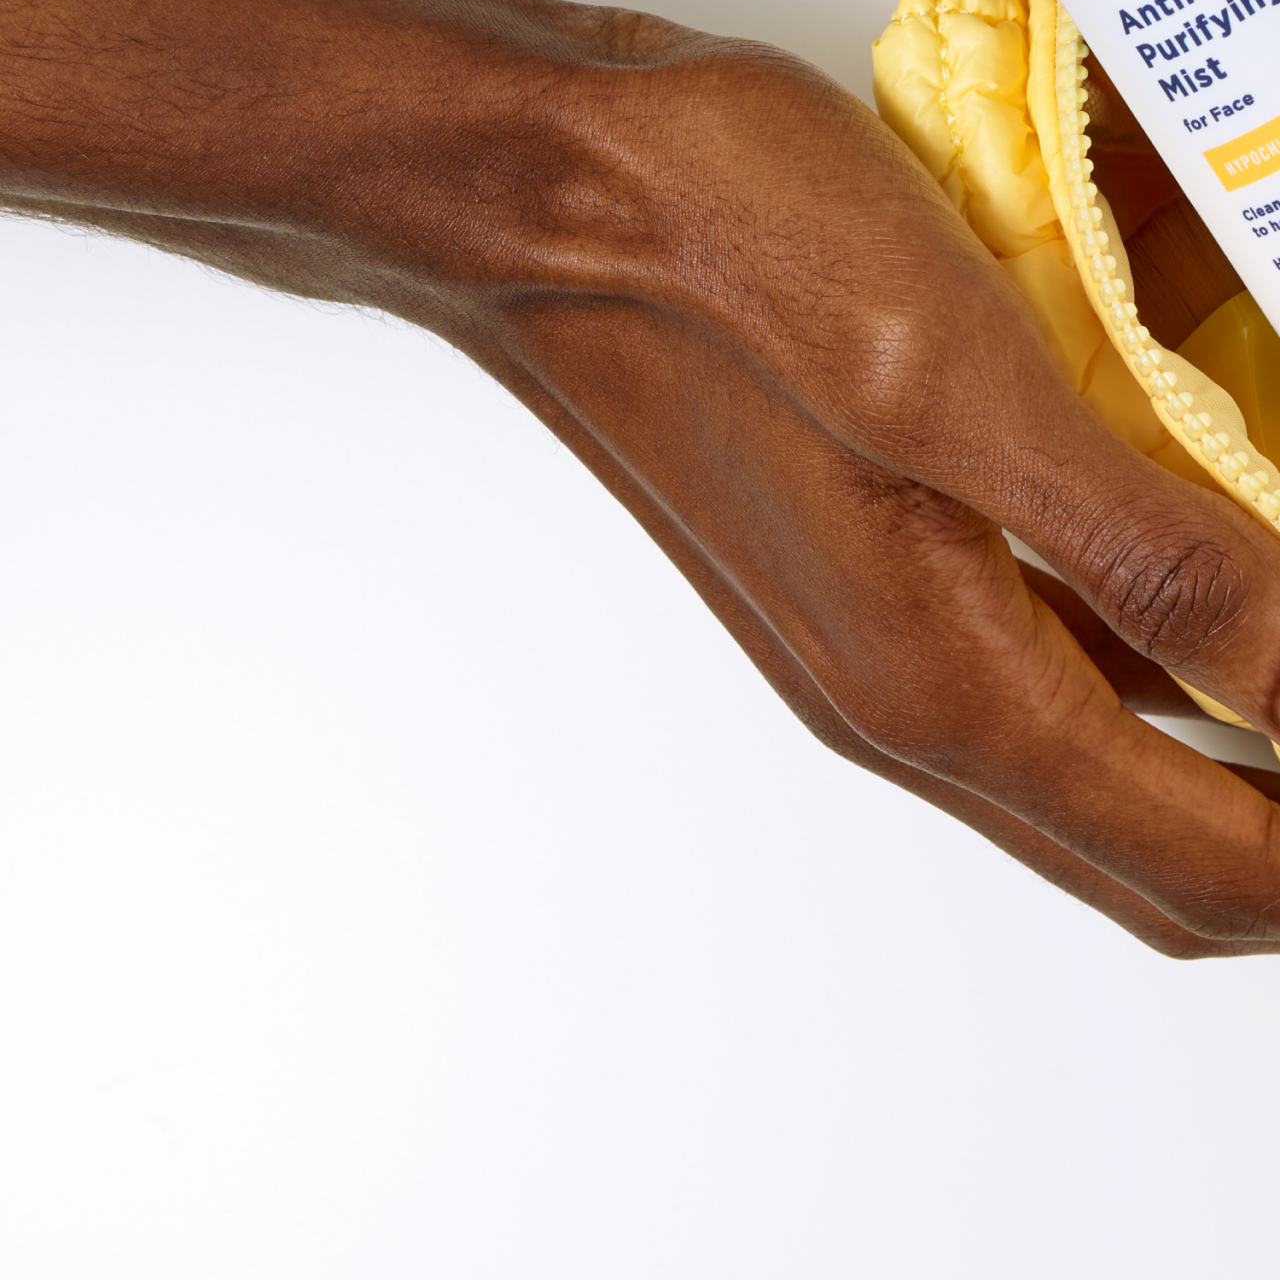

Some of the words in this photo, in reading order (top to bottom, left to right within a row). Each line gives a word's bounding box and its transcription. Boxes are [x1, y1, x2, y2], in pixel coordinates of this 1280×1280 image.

[1157, 56, 1227, 102] Mist
[1183, 116, 1208, 133] for
[1209, 91, 1255, 125] Face
[1252, 224, 1269, 238] to
